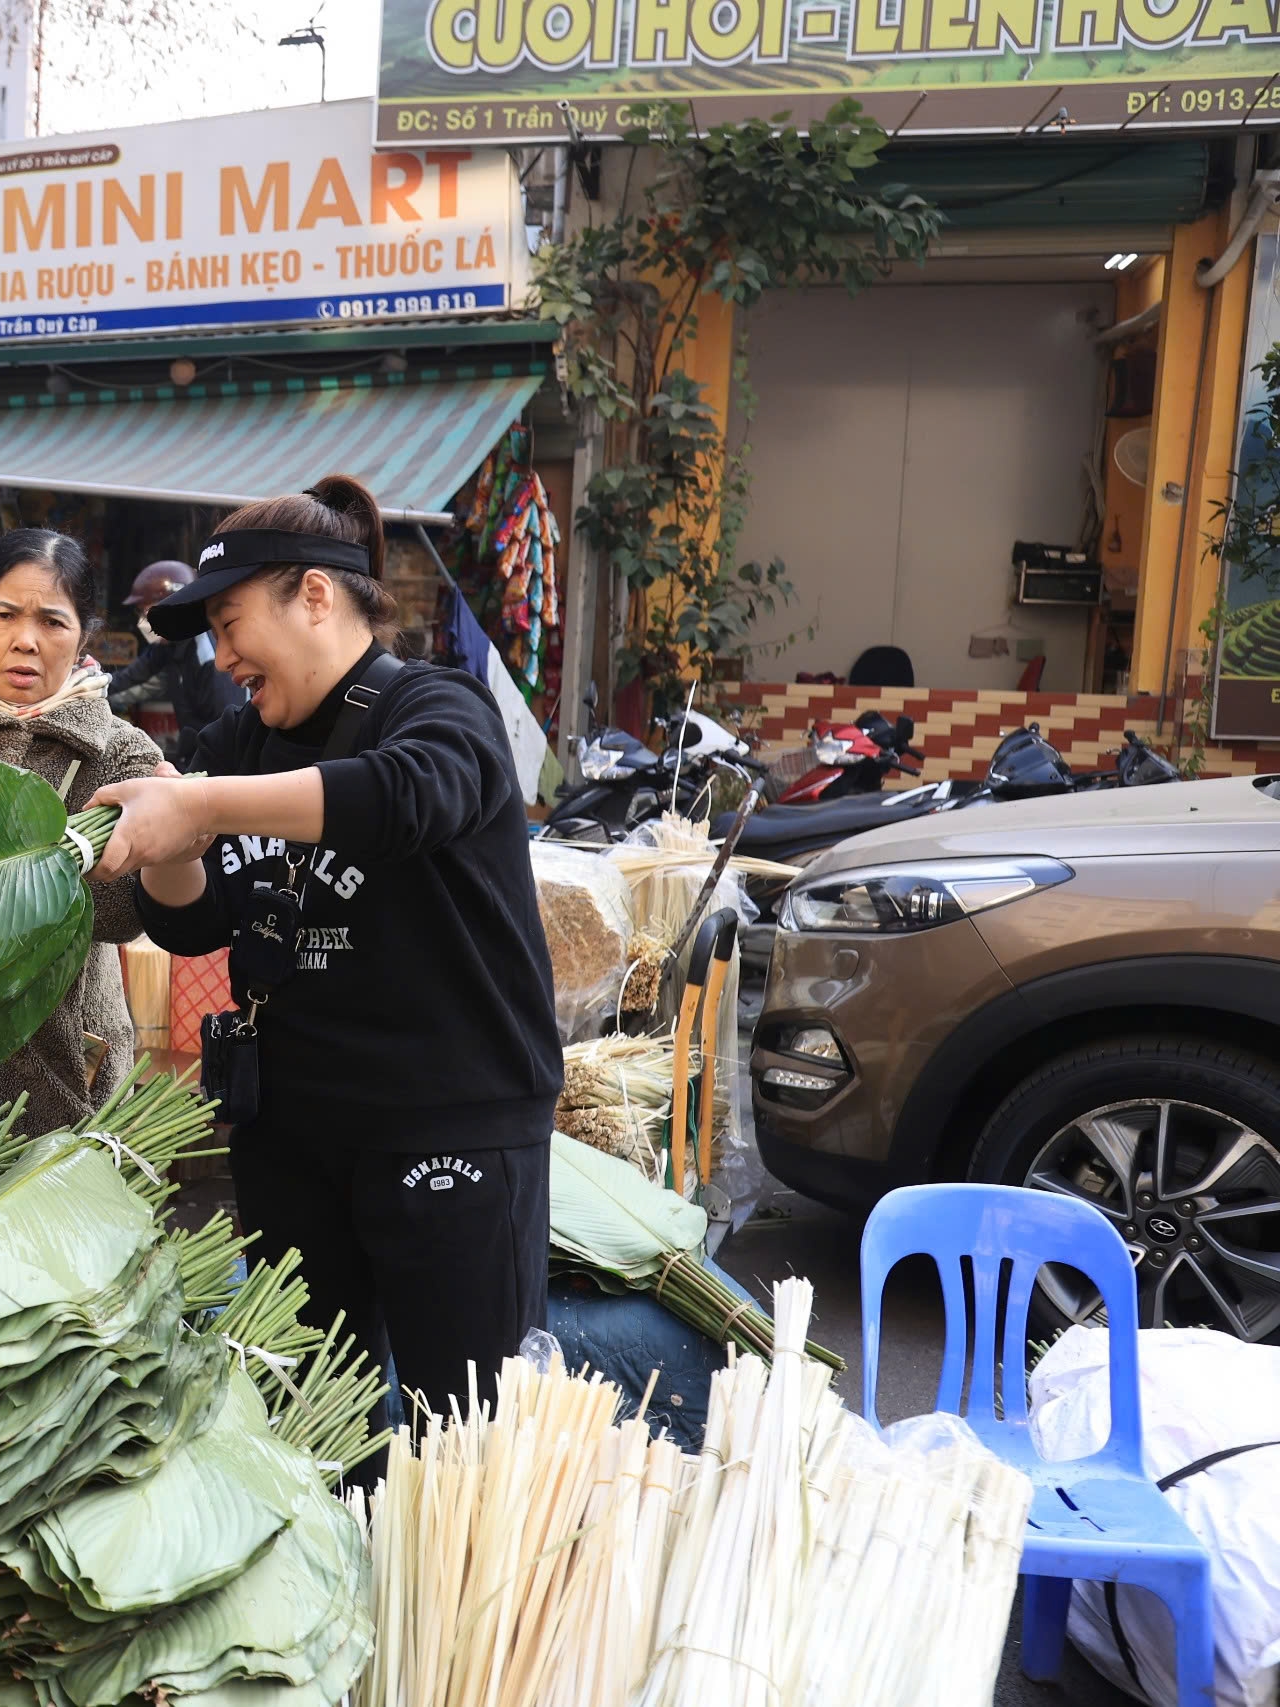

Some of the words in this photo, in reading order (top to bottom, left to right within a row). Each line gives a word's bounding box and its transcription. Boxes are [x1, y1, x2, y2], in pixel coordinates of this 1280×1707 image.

[397, 109, 438, 132] ĐC:
[445, 105, 478, 130] Số
[484, 109, 493, 129] 1
[503, 103, 553, 129] Trần
[1126, 91, 1171, 114] ĐT:
[3, 172, 183, 254] MINI
[219, 150, 473, 236] MART
[37, 261, 114, 305] RƯỢU
[146, 251, 229, 293] BÁNH
[241, 249, 302, 292] KẸO
[335, 227, 443, 280] THUỐC
[456, 225, 497, 271] LÁ
[338, 299, 388, 318] 0912
[394, 294, 432, 314] 999
[437, 291, 477, 310] 619
[402, 1156, 483, 1188] USNAVALS
